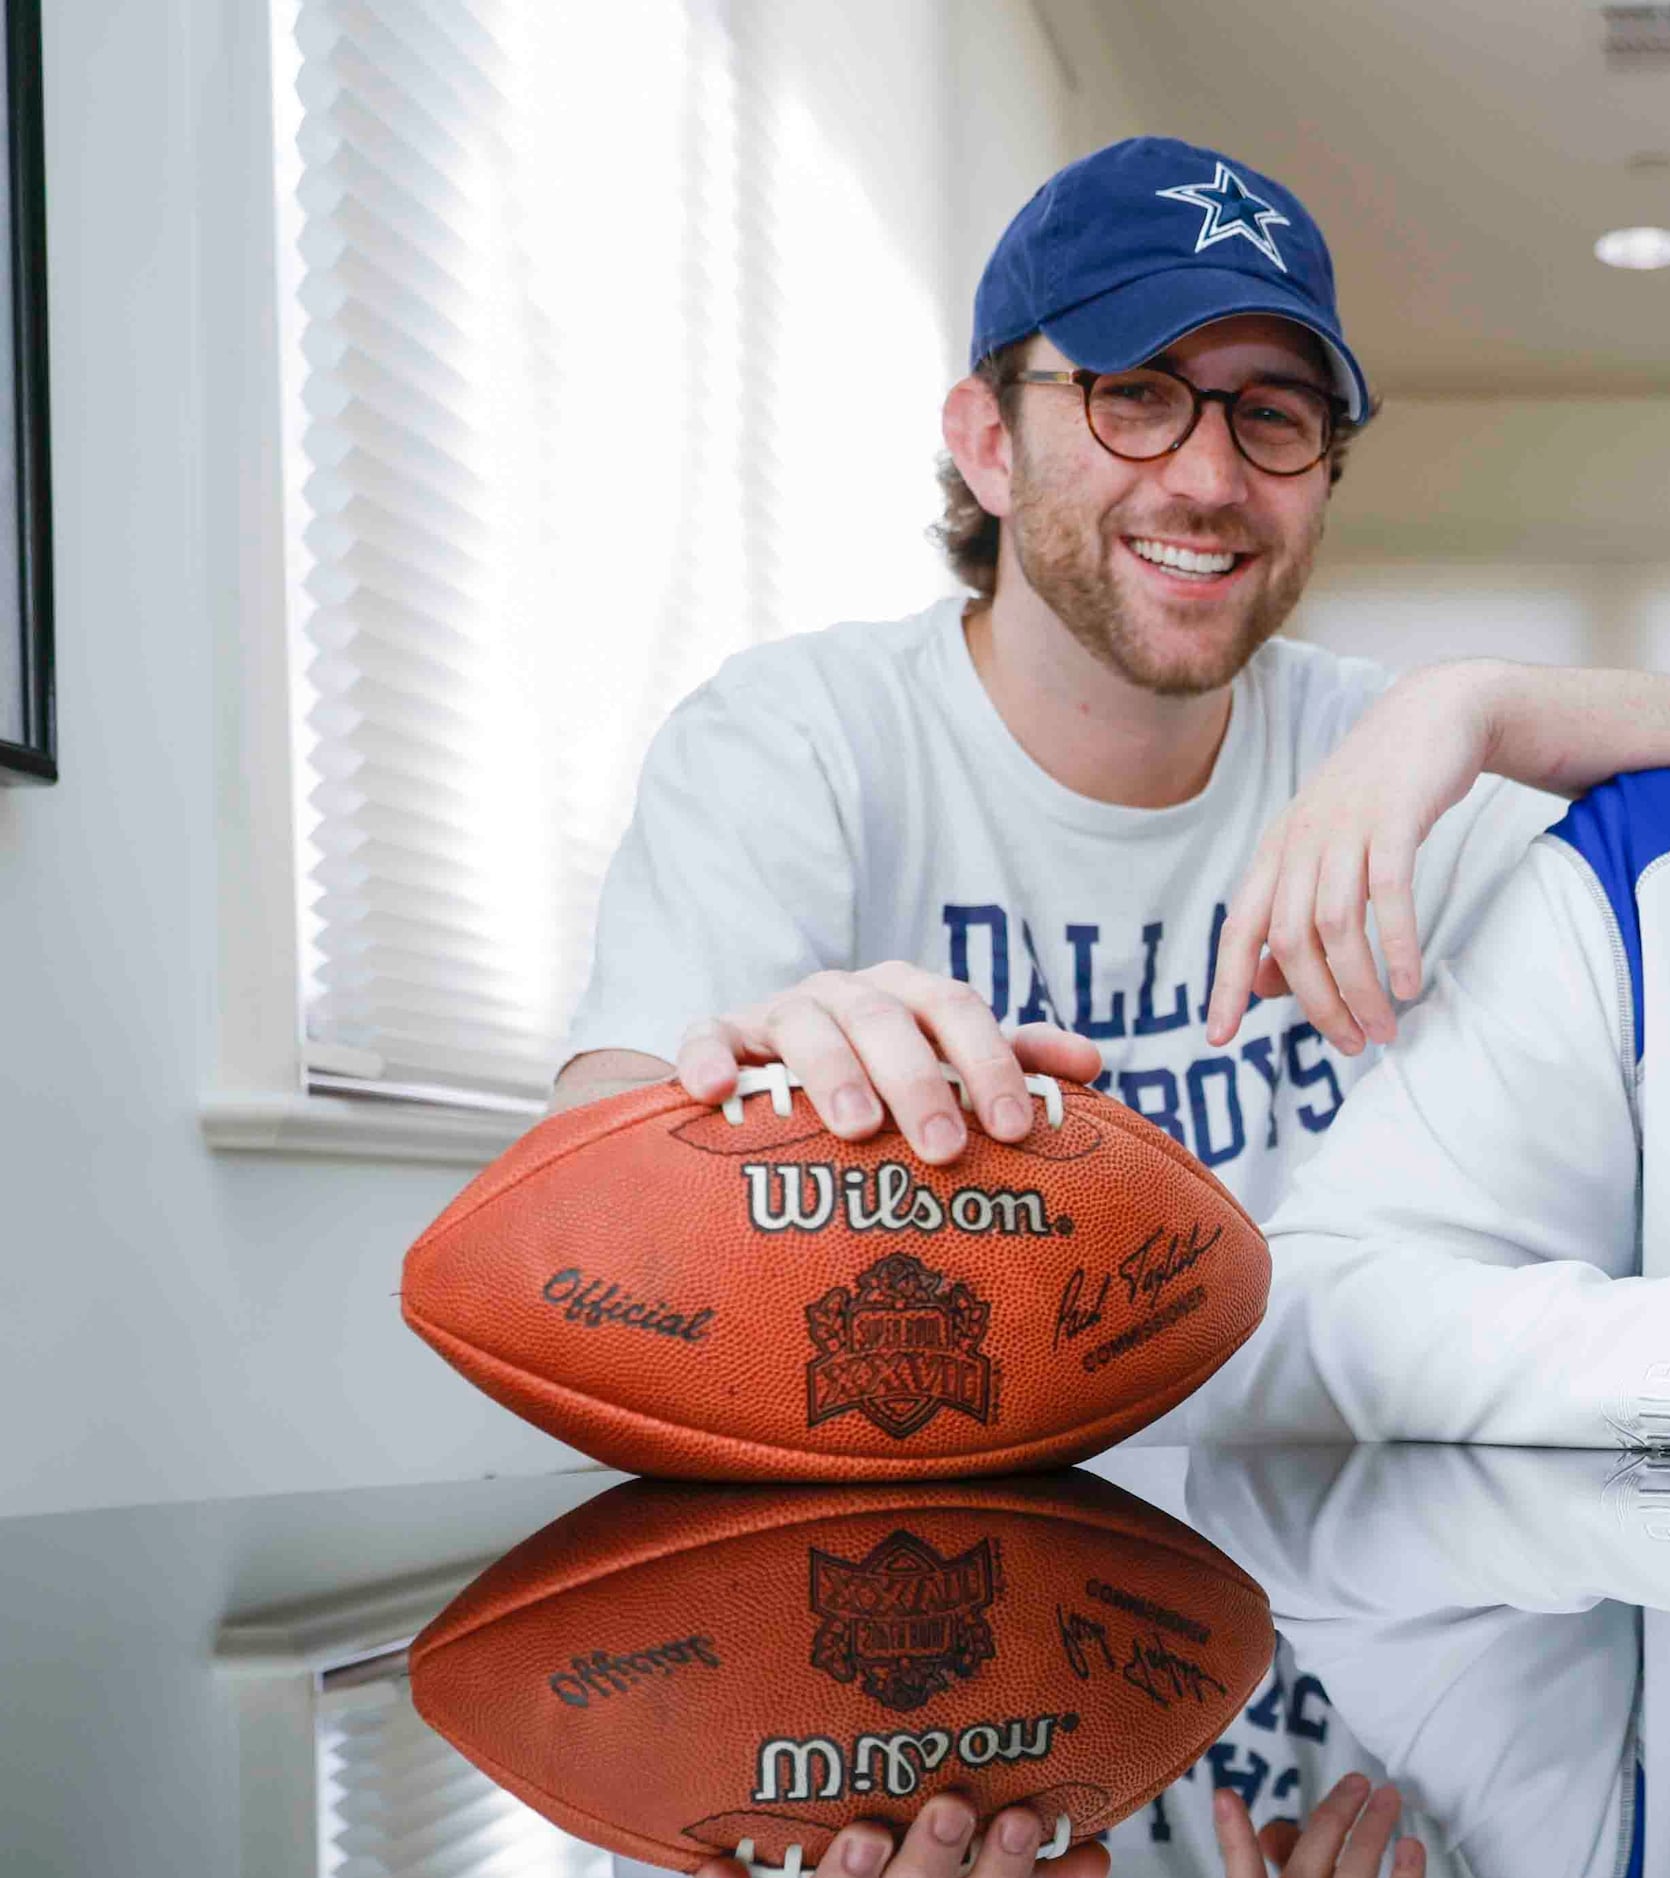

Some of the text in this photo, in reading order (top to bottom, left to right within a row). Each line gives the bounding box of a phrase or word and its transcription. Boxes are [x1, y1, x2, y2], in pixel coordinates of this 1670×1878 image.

[943, 902, 1262, 1039] DALLA
[1093, 1022, 1344, 1168] BOYS
[742, 1159, 1052, 1235] Wilson
[543, 1268, 716, 1342] Official
